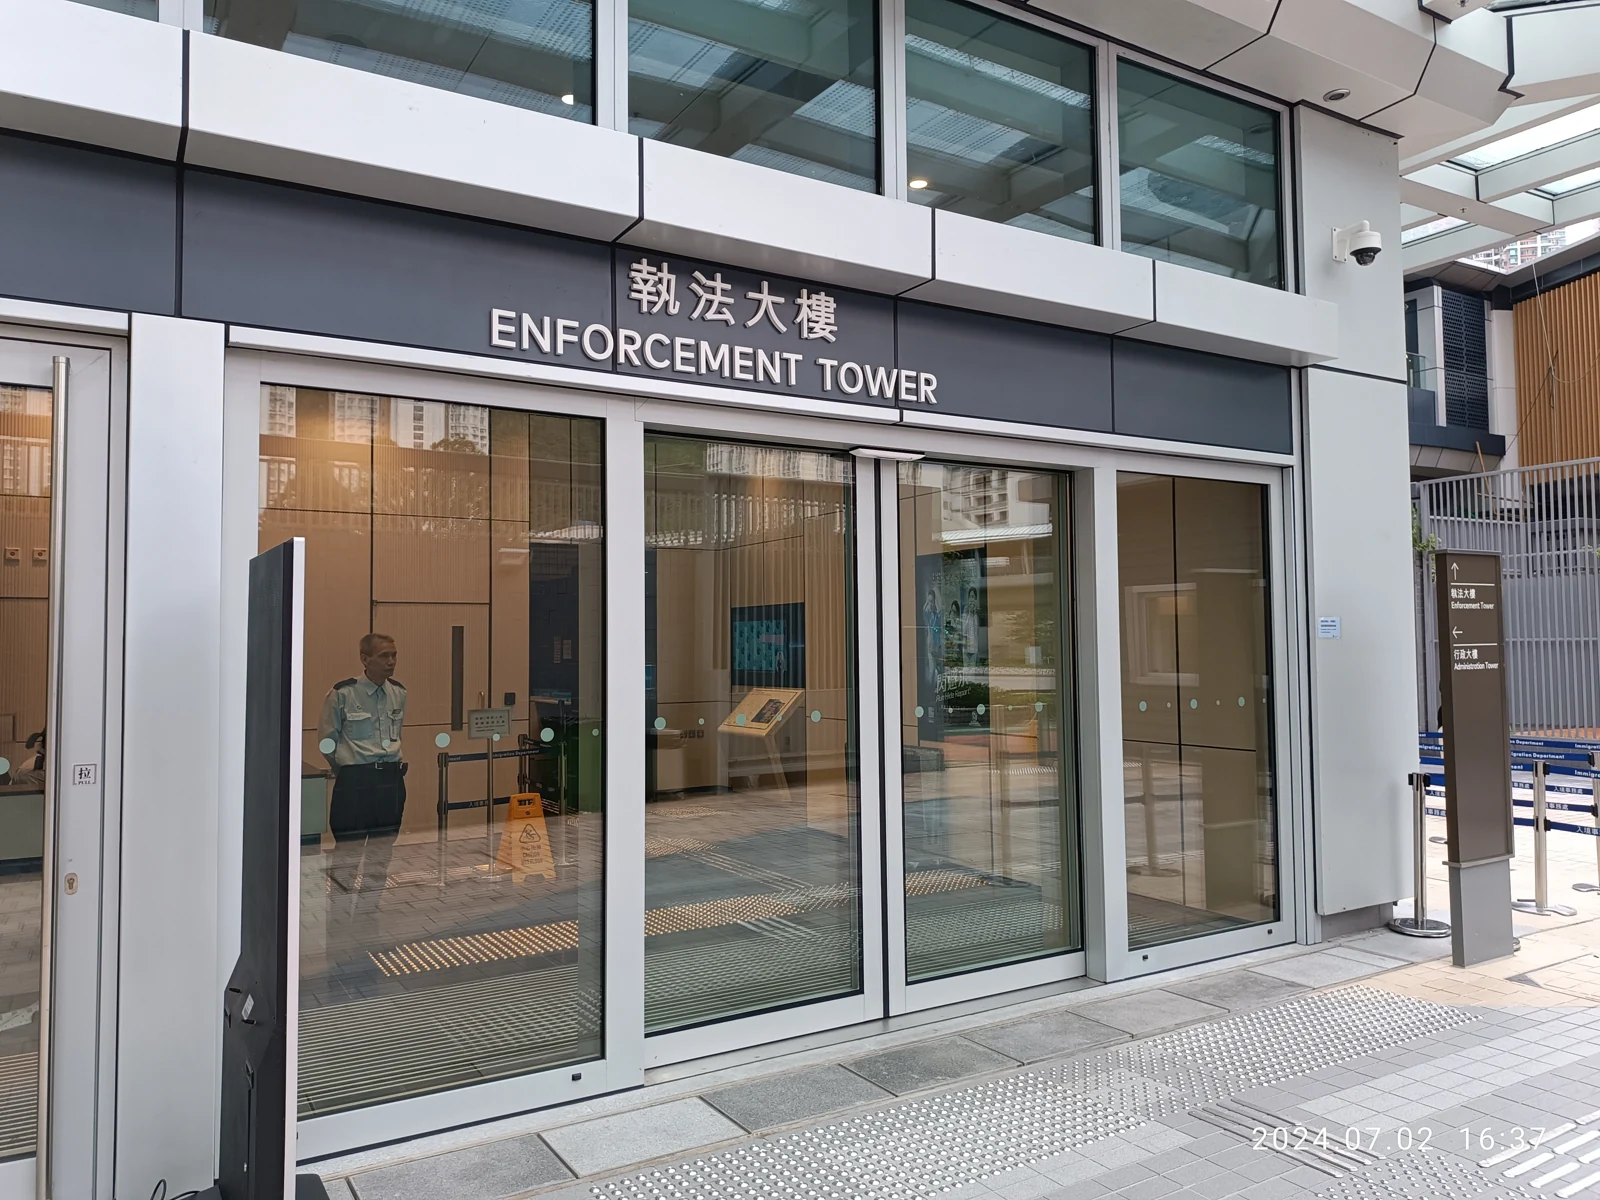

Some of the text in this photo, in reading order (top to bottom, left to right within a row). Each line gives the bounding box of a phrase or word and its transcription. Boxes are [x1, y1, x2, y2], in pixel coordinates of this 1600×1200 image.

[627, 258, 838, 343] 執法大樓
[490, 308, 938, 404] ENFORCEMENT TOWER
[1450, 588, 1476, 599] 執法大樓
[1451, 601, 1495, 610] Enforcement Tower
[1453, 648, 1478, 660] 行政大樓
[1453, 661, 1499, 671] Administration Tower
[1574, 743, 1600, 751] Immigrati
[1533, 752, 1565, 760] Department
[78, 767, 91, 780] 拉
[1574, 769, 1600, 779] Immigra
